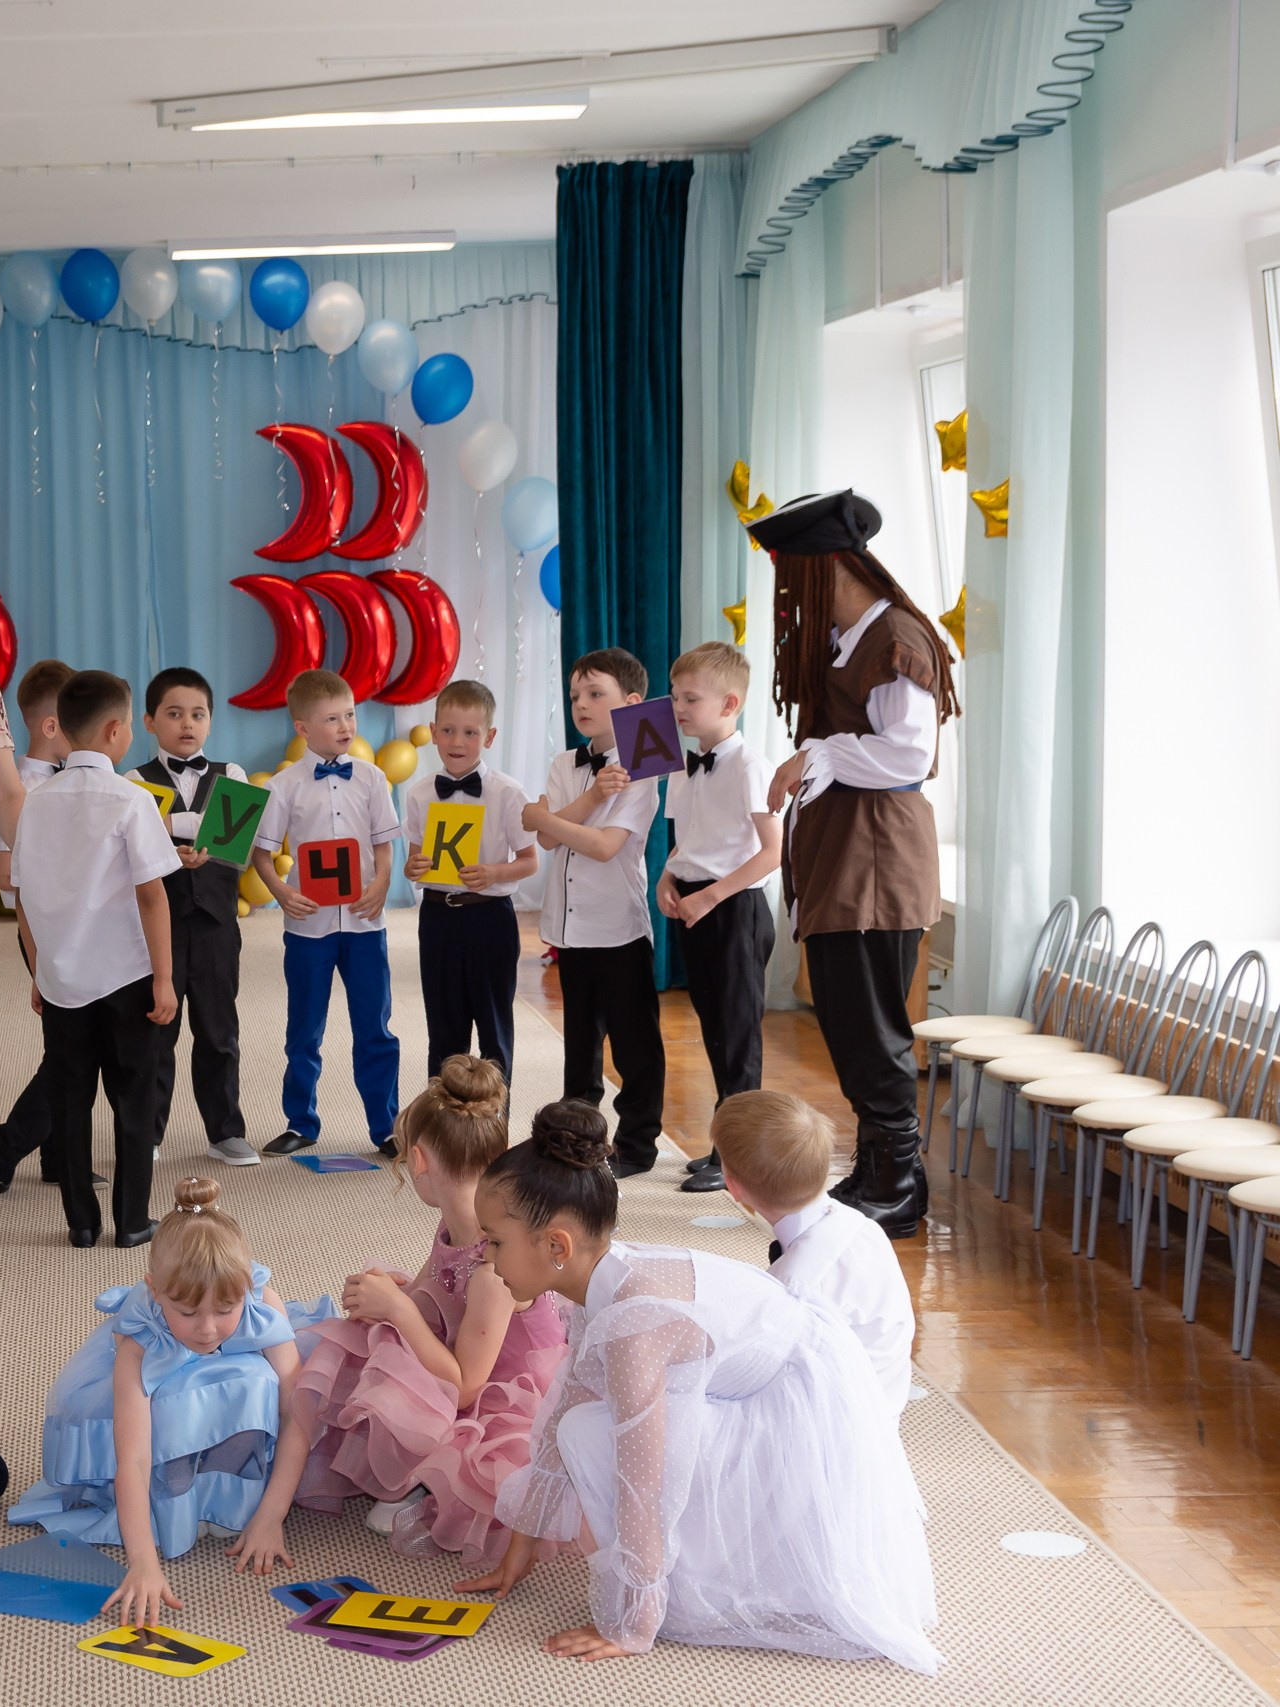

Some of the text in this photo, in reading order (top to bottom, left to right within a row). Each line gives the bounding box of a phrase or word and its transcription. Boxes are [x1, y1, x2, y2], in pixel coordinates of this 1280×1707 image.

[631, 717, 677, 771] А
[212, 793, 262, 846] У
[308, 847, 352, 897] Ч
[430, 821, 475, 873] К
